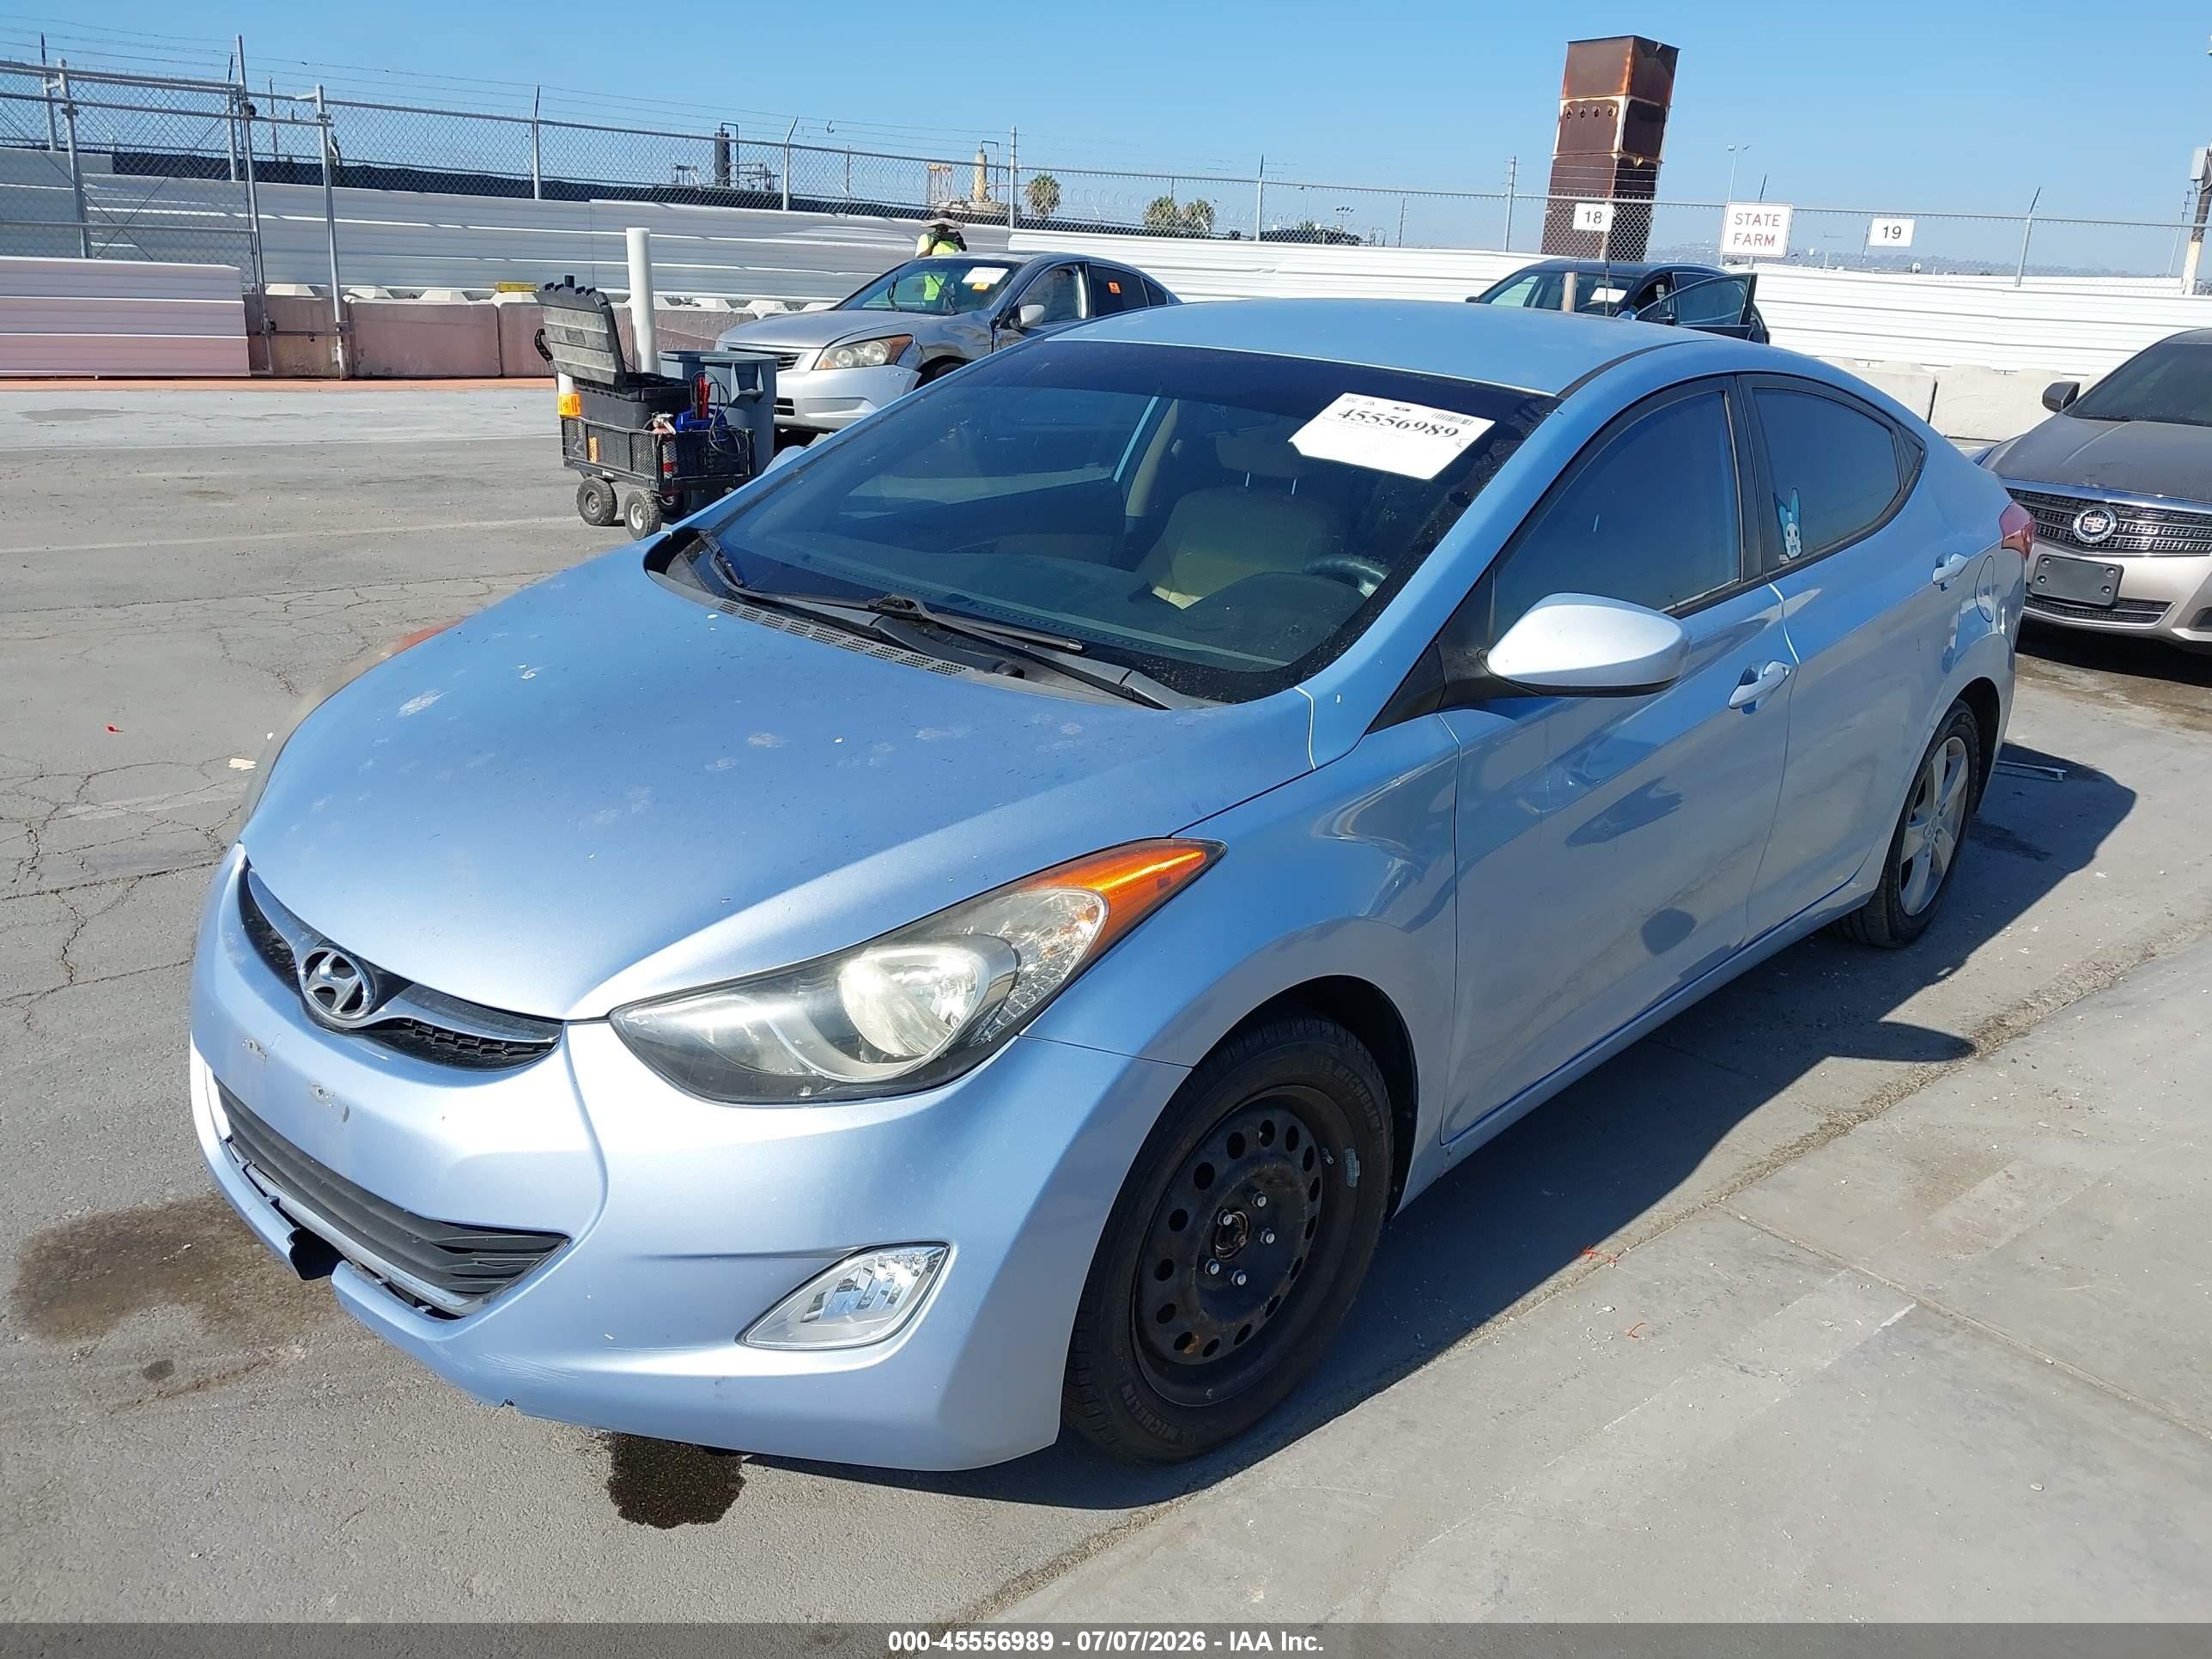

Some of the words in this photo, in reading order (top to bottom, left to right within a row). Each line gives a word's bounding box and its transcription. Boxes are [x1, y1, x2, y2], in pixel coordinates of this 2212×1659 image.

[1584, 210, 1603, 225] 18
[1734, 213, 1781, 228] STATE
[1732, 233, 1777, 247] FARM
[1882, 225, 1903, 240] 19
[1338, 408, 1459, 438] 45556989
[1121, 1383, 1182, 1443] MICHELIN
